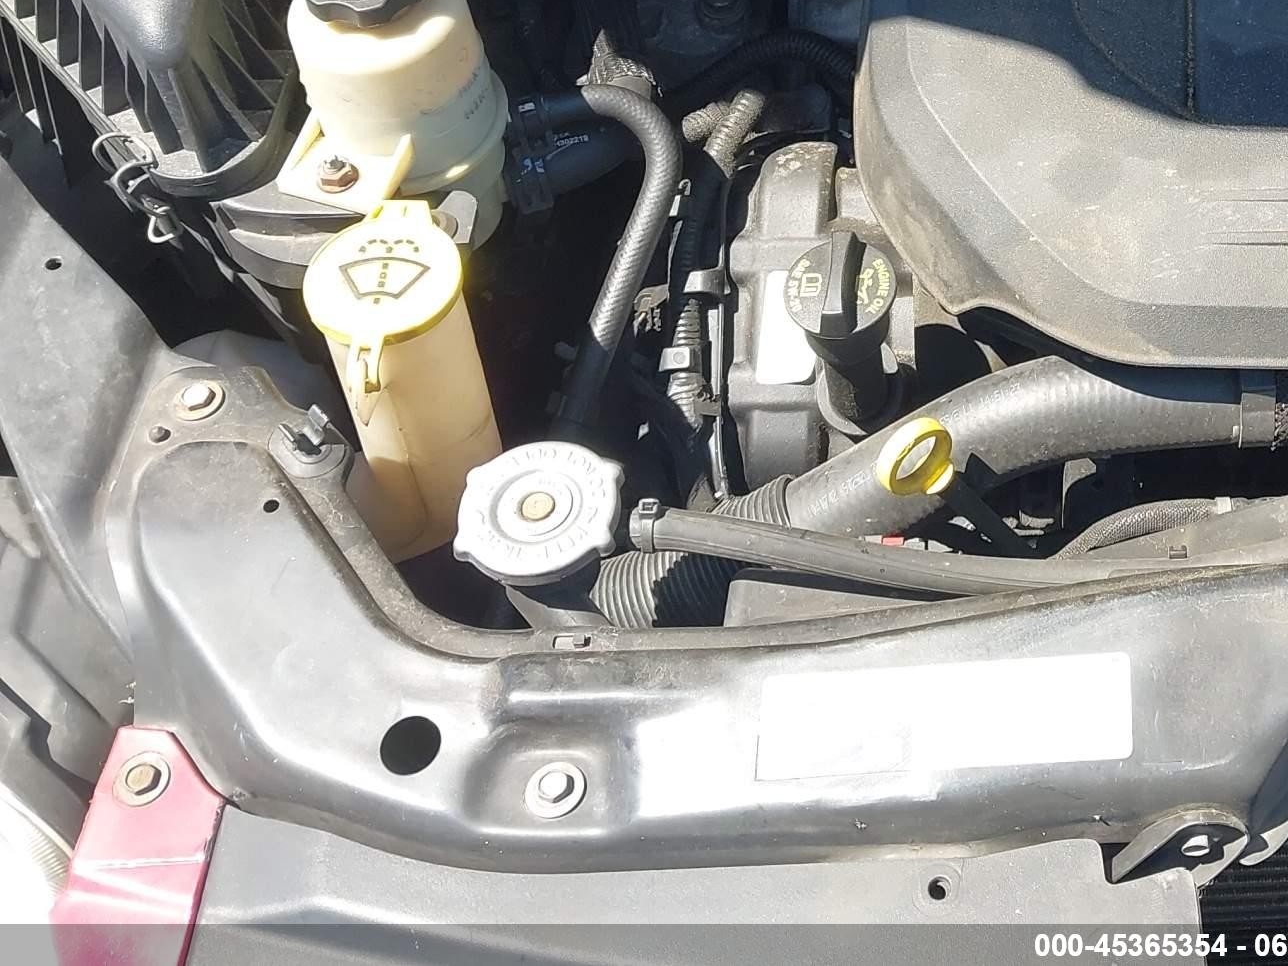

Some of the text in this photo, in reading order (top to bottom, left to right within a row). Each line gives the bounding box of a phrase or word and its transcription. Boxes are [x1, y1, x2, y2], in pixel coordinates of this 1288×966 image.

[791, 258, 811, 282] SAE
[865, 258, 891, 314] ENGINE OIL
